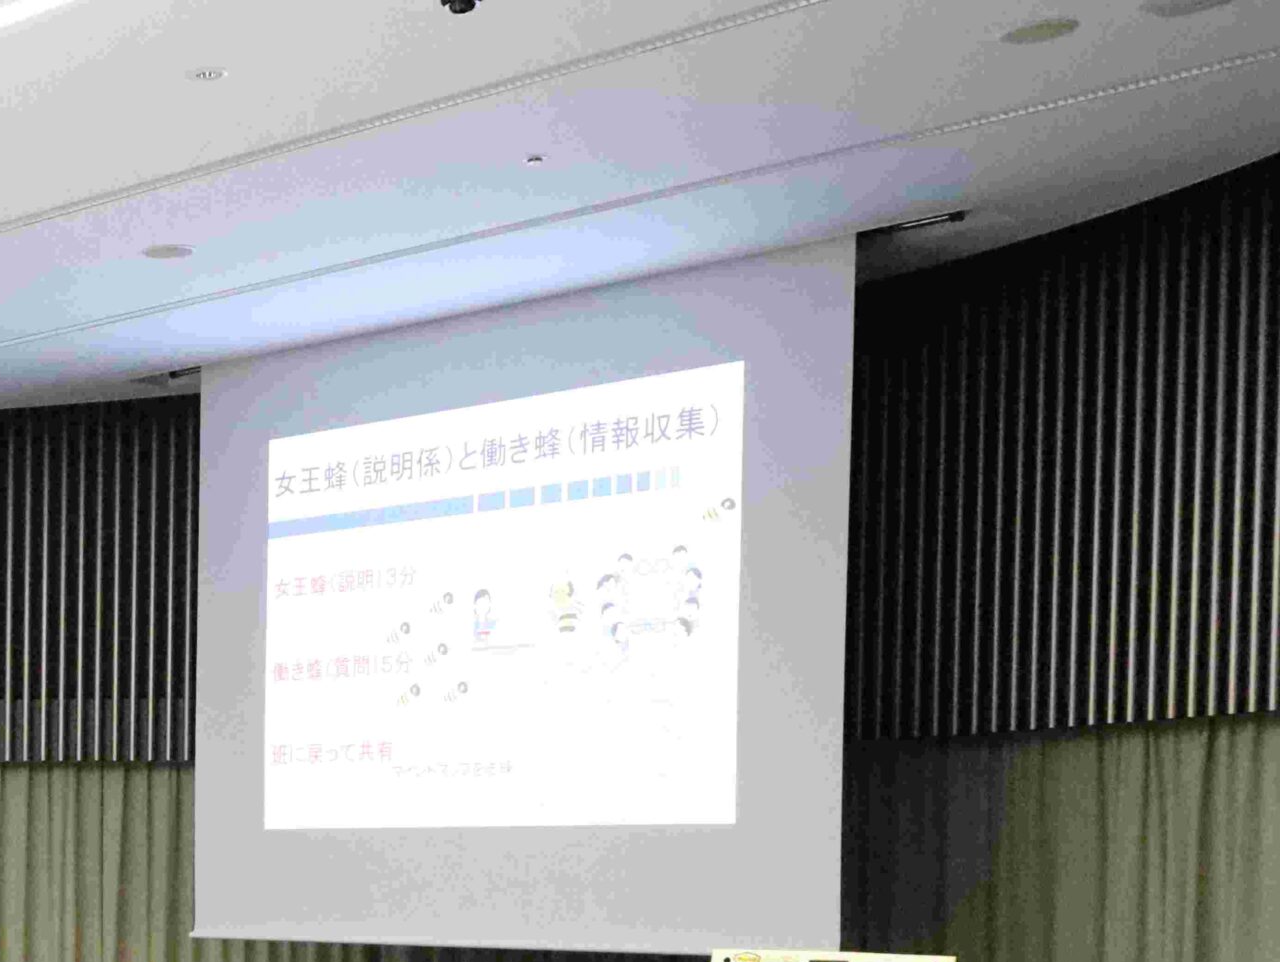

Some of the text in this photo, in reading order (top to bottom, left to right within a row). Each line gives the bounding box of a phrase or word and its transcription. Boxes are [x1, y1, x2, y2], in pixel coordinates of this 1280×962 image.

[274, 404, 720, 499] 女王蜂(説明係)と働き蜂(情報収集)
